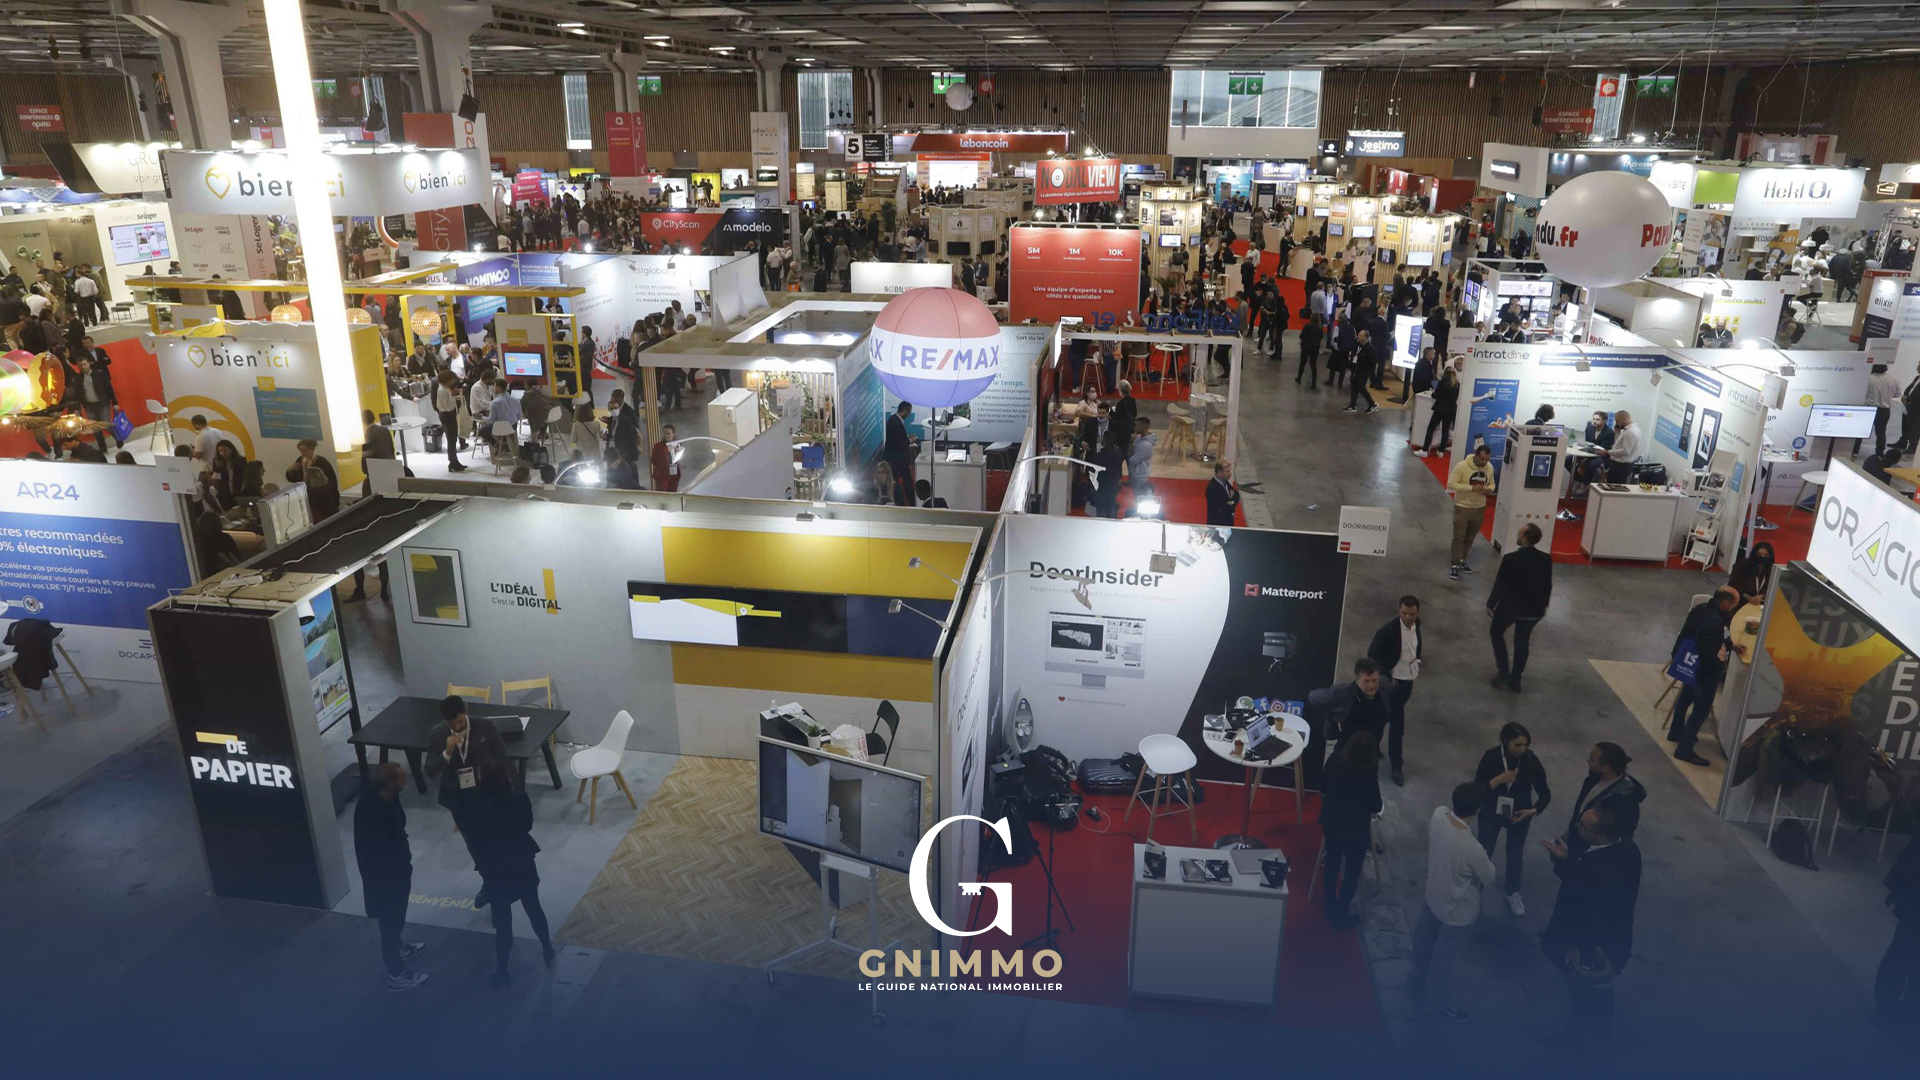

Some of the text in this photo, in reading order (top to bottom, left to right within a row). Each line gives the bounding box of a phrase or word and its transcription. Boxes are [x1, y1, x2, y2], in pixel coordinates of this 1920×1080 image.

[848, 138, 859, 154] 5
[960, 138, 1008, 148] leboncoin
[1359, 140, 1399, 152] jestimo
[1041, 165, 1116, 190] NODALVIEW
[137, 212, 157, 220] SeLoger
[184, 226, 204, 234] SeLoger
[662, 220, 700, 229] CityScan
[1047, 286, 1068, 294] équipe
[900, 344, 999, 370] RE/MAX
[1473, 348, 1529, 360] intratone
[17, 481, 80, 501] AR24
[1342, 522, 1387, 532] DOORINSIDER
[24, 530, 124, 545] recommandées
[18, 542, 108, 559] électroniques.
[46, 565, 89, 574] procédures
[1030, 561, 1163, 588] DoorInsider
[0, 580, 31, 590] Envoyez
[46, 583, 61, 591] LRE
[61, 584, 75, 594] 7j/7
[86, 586, 112, 595] 24h/24
[68, 577, 101, 585] courriers
[126, 582, 156, 590] preuves
[491, 583, 537, 596] L'IDÉAL
[1262, 586, 1324, 600] Matterport
[492, 597, 508, 605] C'est
[517, 597, 562, 610] DIGITAL
[225, 740, 248, 755] DE
[190, 756, 294, 789] PAPIER
